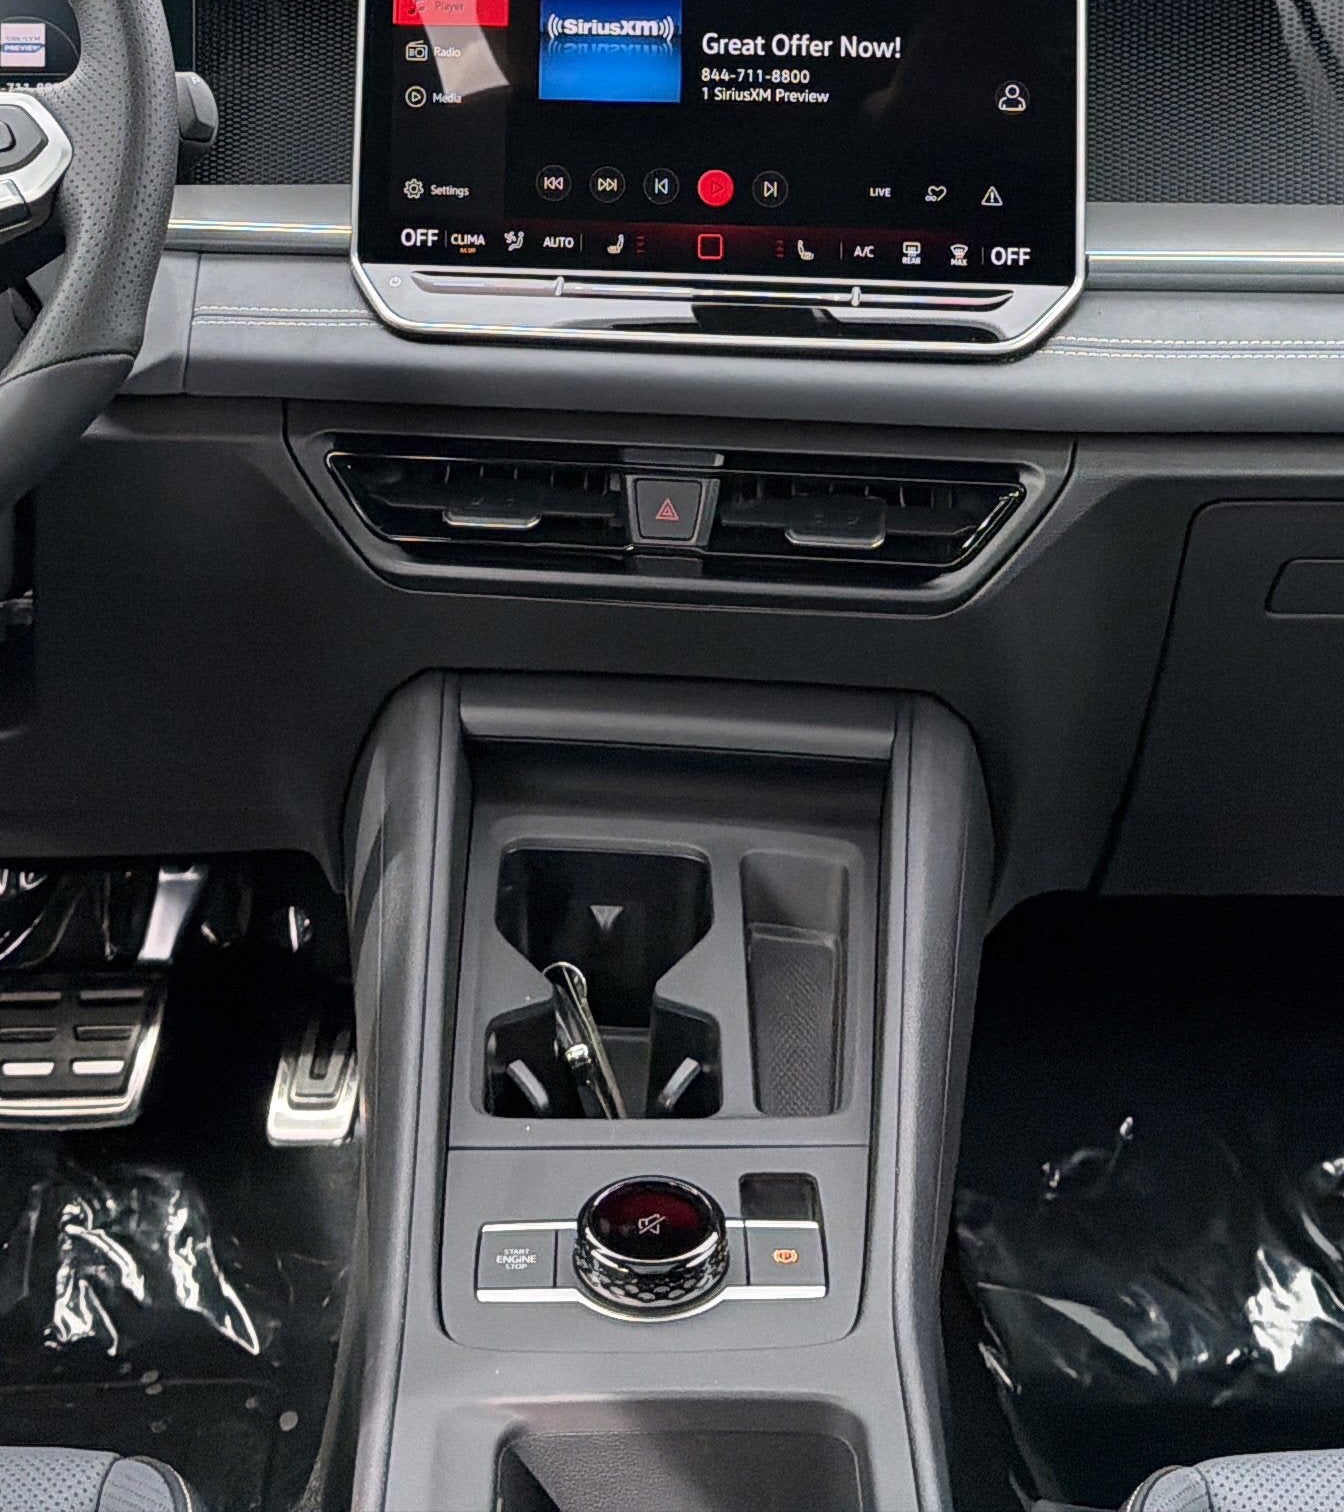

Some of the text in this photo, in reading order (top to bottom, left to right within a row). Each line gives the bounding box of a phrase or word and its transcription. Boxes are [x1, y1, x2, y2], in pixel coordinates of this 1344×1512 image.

[434, 0, 464, 12] Player
[433, 46, 462, 58] Radio
[701, 32, 902, 59] Great Offer Now!
[700, 67, 811, 84] 844-711-8800
[432, 92, 463, 104] Media
[702, 87, 831, 104] 1 SiriusXM Preview
[430, 184, 470, 199] Settings
[869, 187, 892, 198] LIVE
[400, 228, 439, 247] OFF
[450, 233, 486, 246] CLIMA
[543, 236, 575, 249] AUTO
[853, 245, 875, 258] A/C
[990, 246, 1032, 266] OFF
[901, 256, 922, 265] REAR
[950, 257, 969, 267] MAX
[495, 1254, 537, 1264] ENGINE
